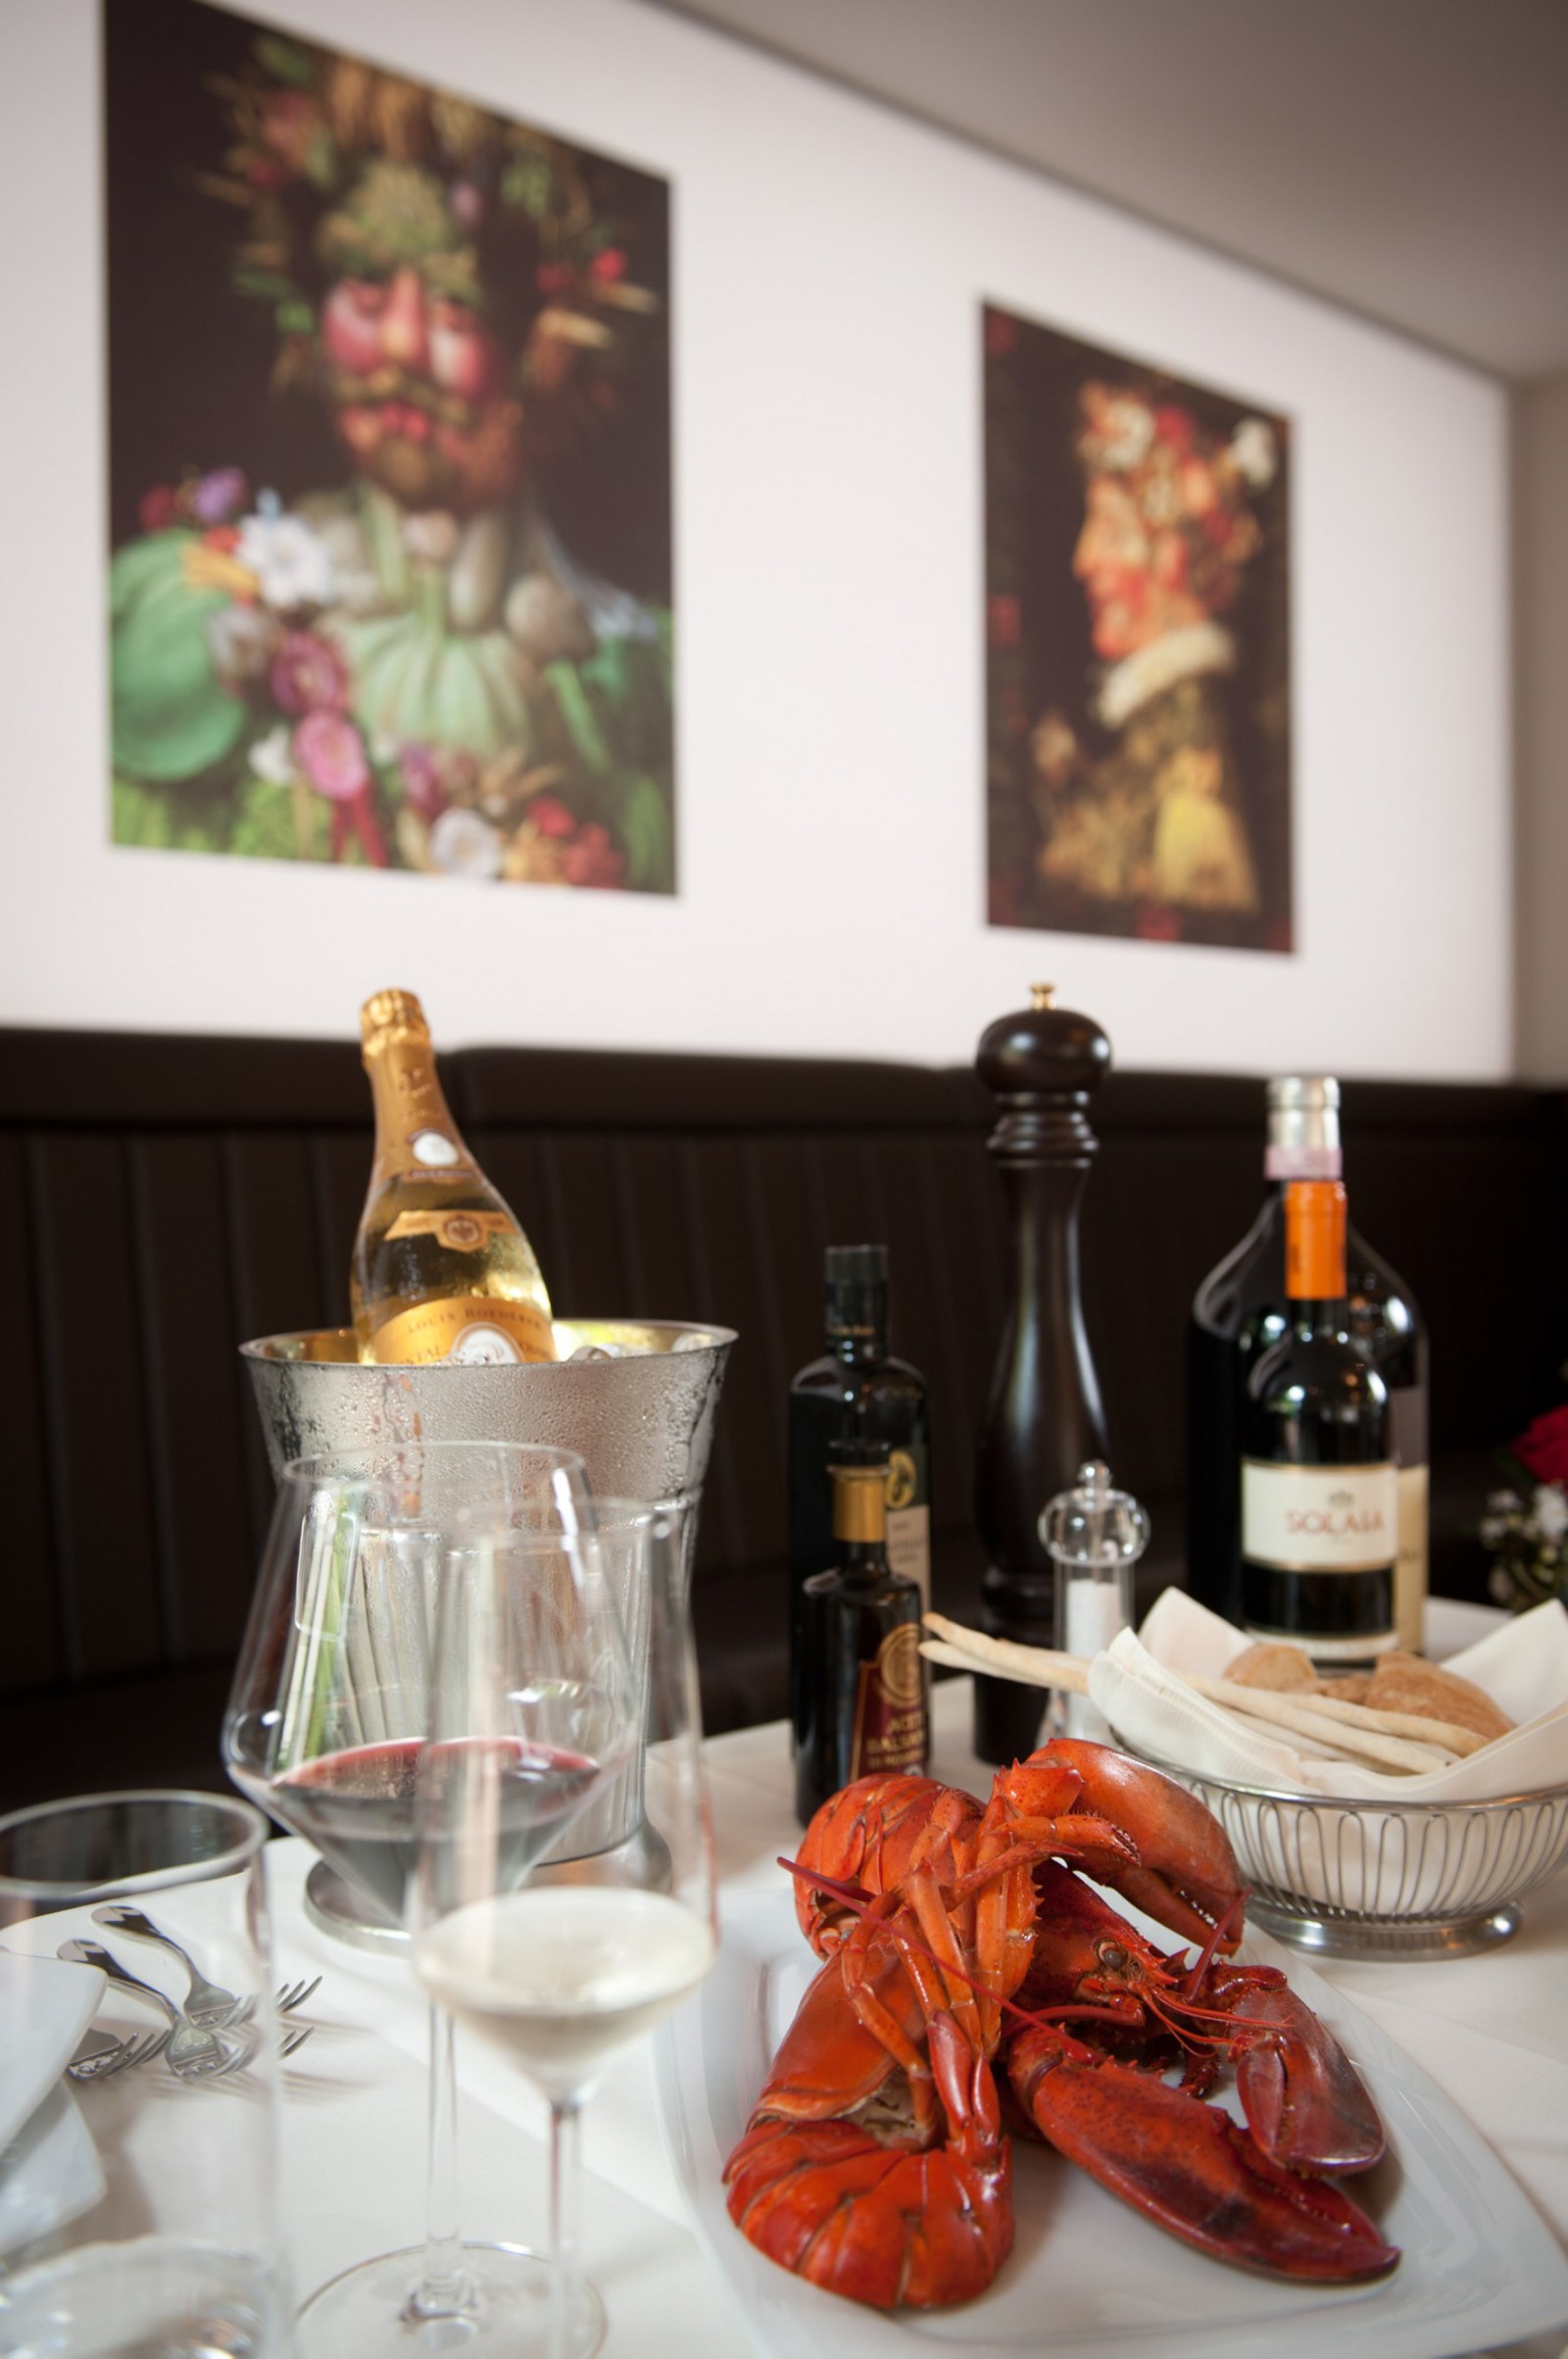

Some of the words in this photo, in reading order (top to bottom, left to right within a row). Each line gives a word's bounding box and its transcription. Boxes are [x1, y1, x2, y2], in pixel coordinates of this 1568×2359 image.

[407, 1311, 456, 1333] LOUIS
[465, 1307, 542, 1330] ROEDERER
[1286, 1509, 1386, 1536] SOLAIA
